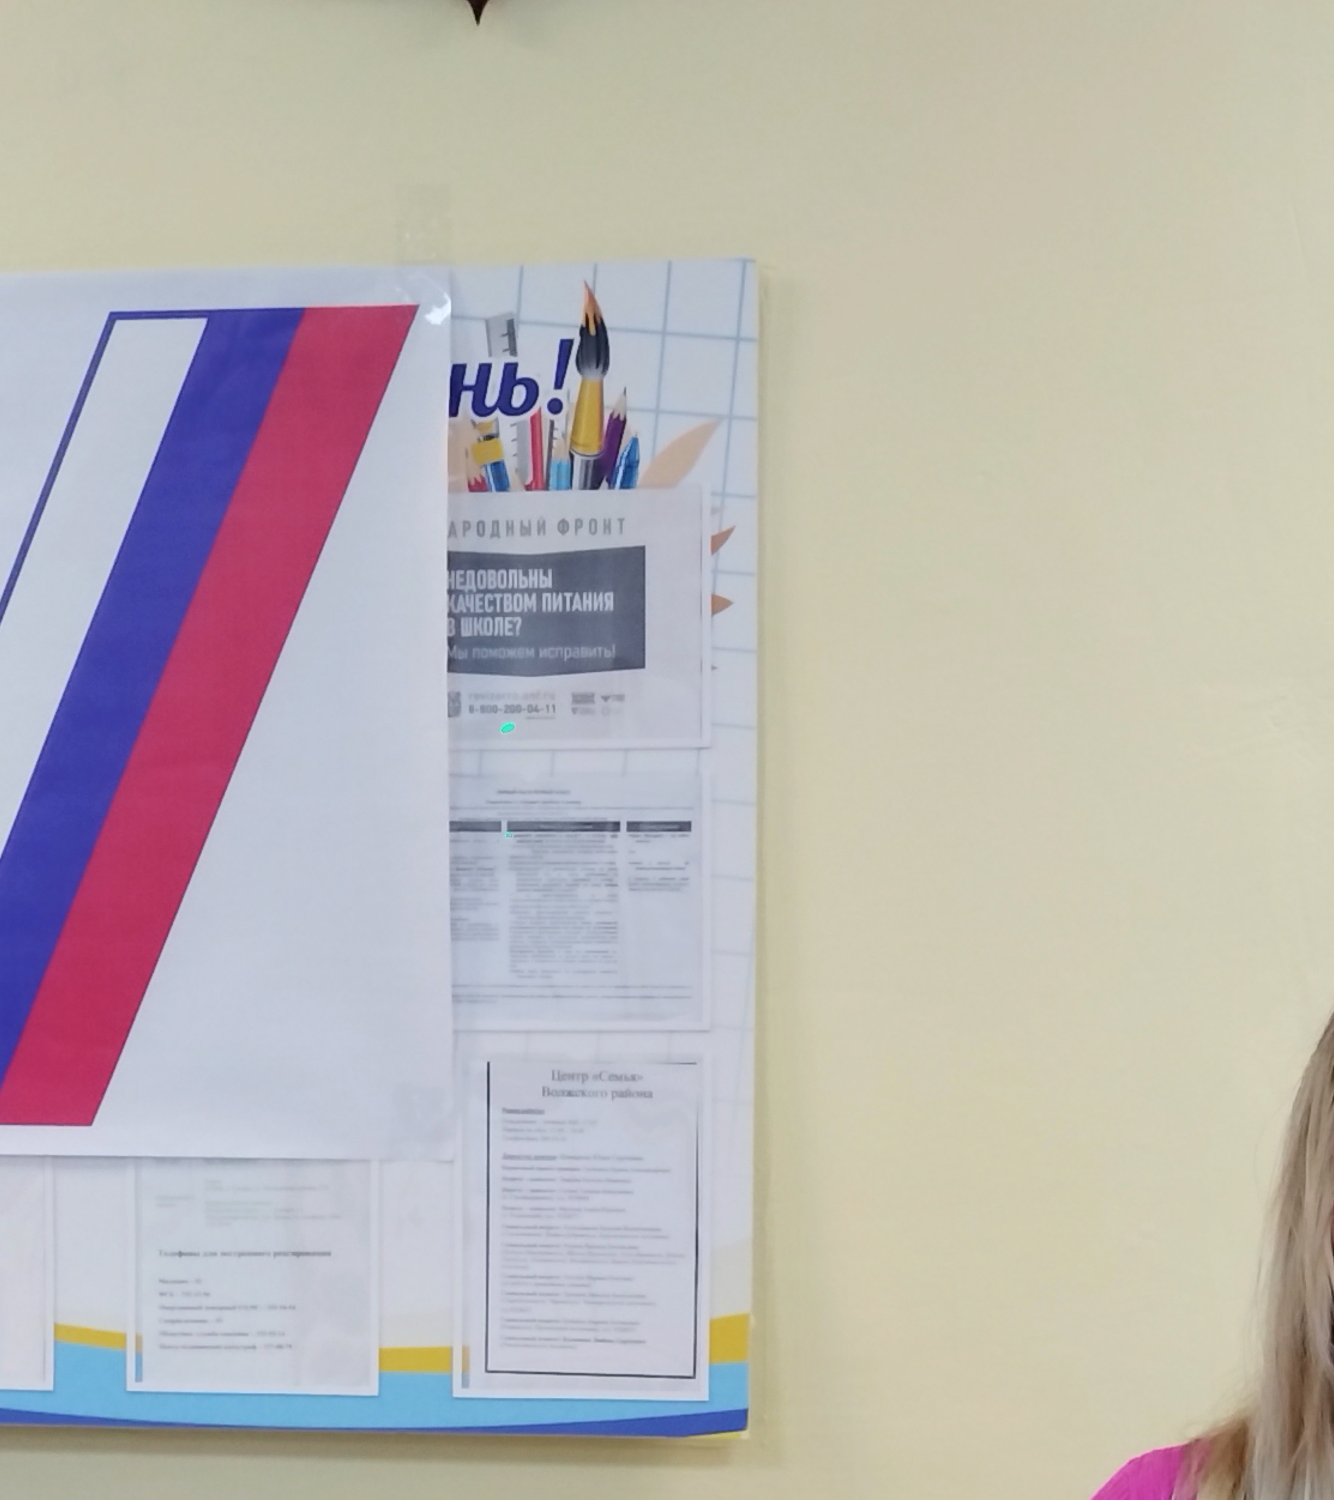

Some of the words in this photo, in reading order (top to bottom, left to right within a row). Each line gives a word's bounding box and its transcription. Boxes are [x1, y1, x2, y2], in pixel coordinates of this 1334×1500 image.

[557, 518, 625, 536] ФРОНТ
[447, 569, 552, 592] НЕДОВОЛЬНЫ
[447, 592, 537, 613] КАЧЕСТВОМ
[542, 592, 614, 612] ПИТАНИЯ
[461, 616, 522, 637] ШКОЛЕ?
[472, 648, 535, 659] поможем
[539, 644, 616, 661] исправить!
[551, 1069, 589, 1084] Центр
[611, 1088, 653, 1101] района
